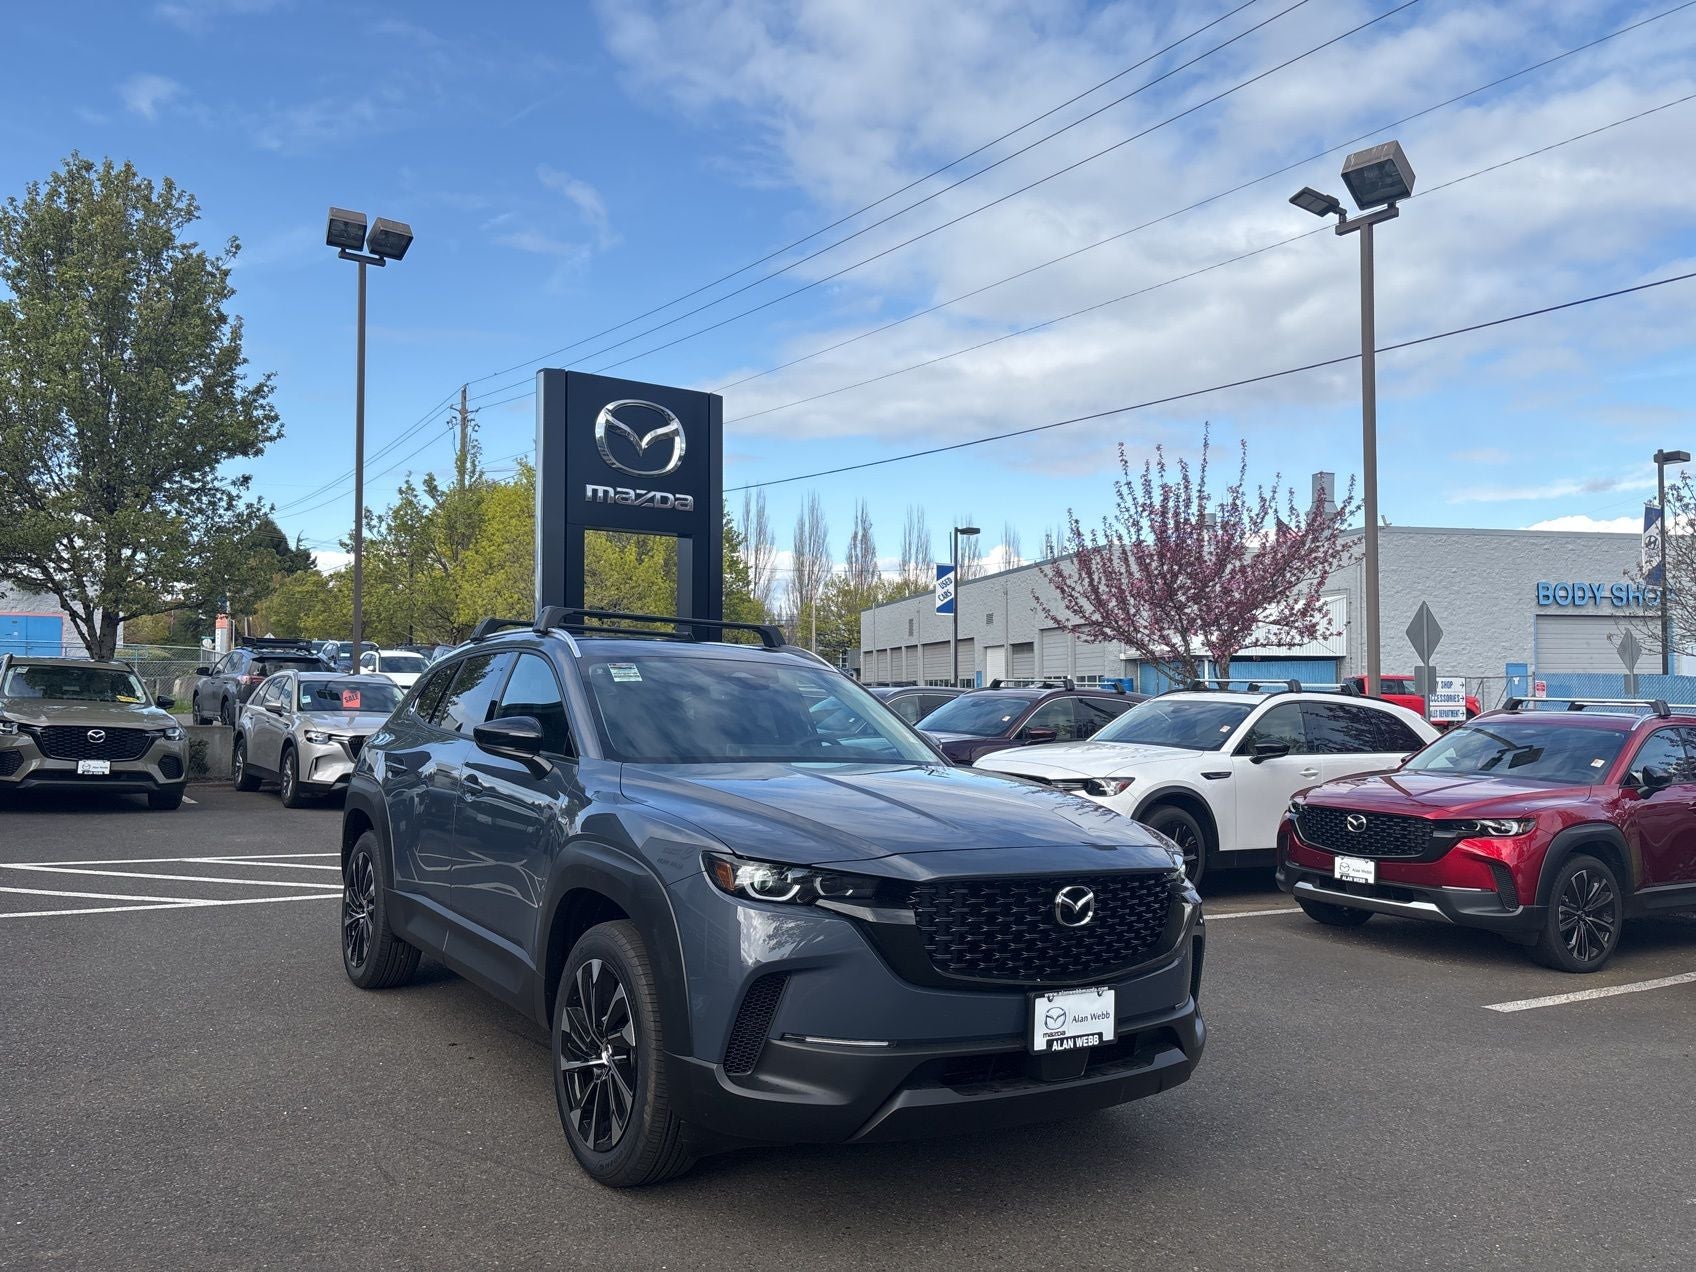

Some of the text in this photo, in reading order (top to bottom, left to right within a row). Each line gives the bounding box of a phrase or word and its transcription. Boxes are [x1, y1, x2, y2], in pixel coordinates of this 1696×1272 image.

[585, 484, 694, 512] mazda
[938, 577, 953, 590] USED
[938, 589, 952, 601] CARS
[1537, 582, 1676, 608] BODY SHO
[1441, 681, 1453, 689] SHOP
[344, 693, 360, 703] SALE
[1430, 694, 1460, 702] CCESSORIES
[1072, 1011, 1110, 1023] Alan Webb
[1052, 1035, 1099, 1051] ALAN WEBB
